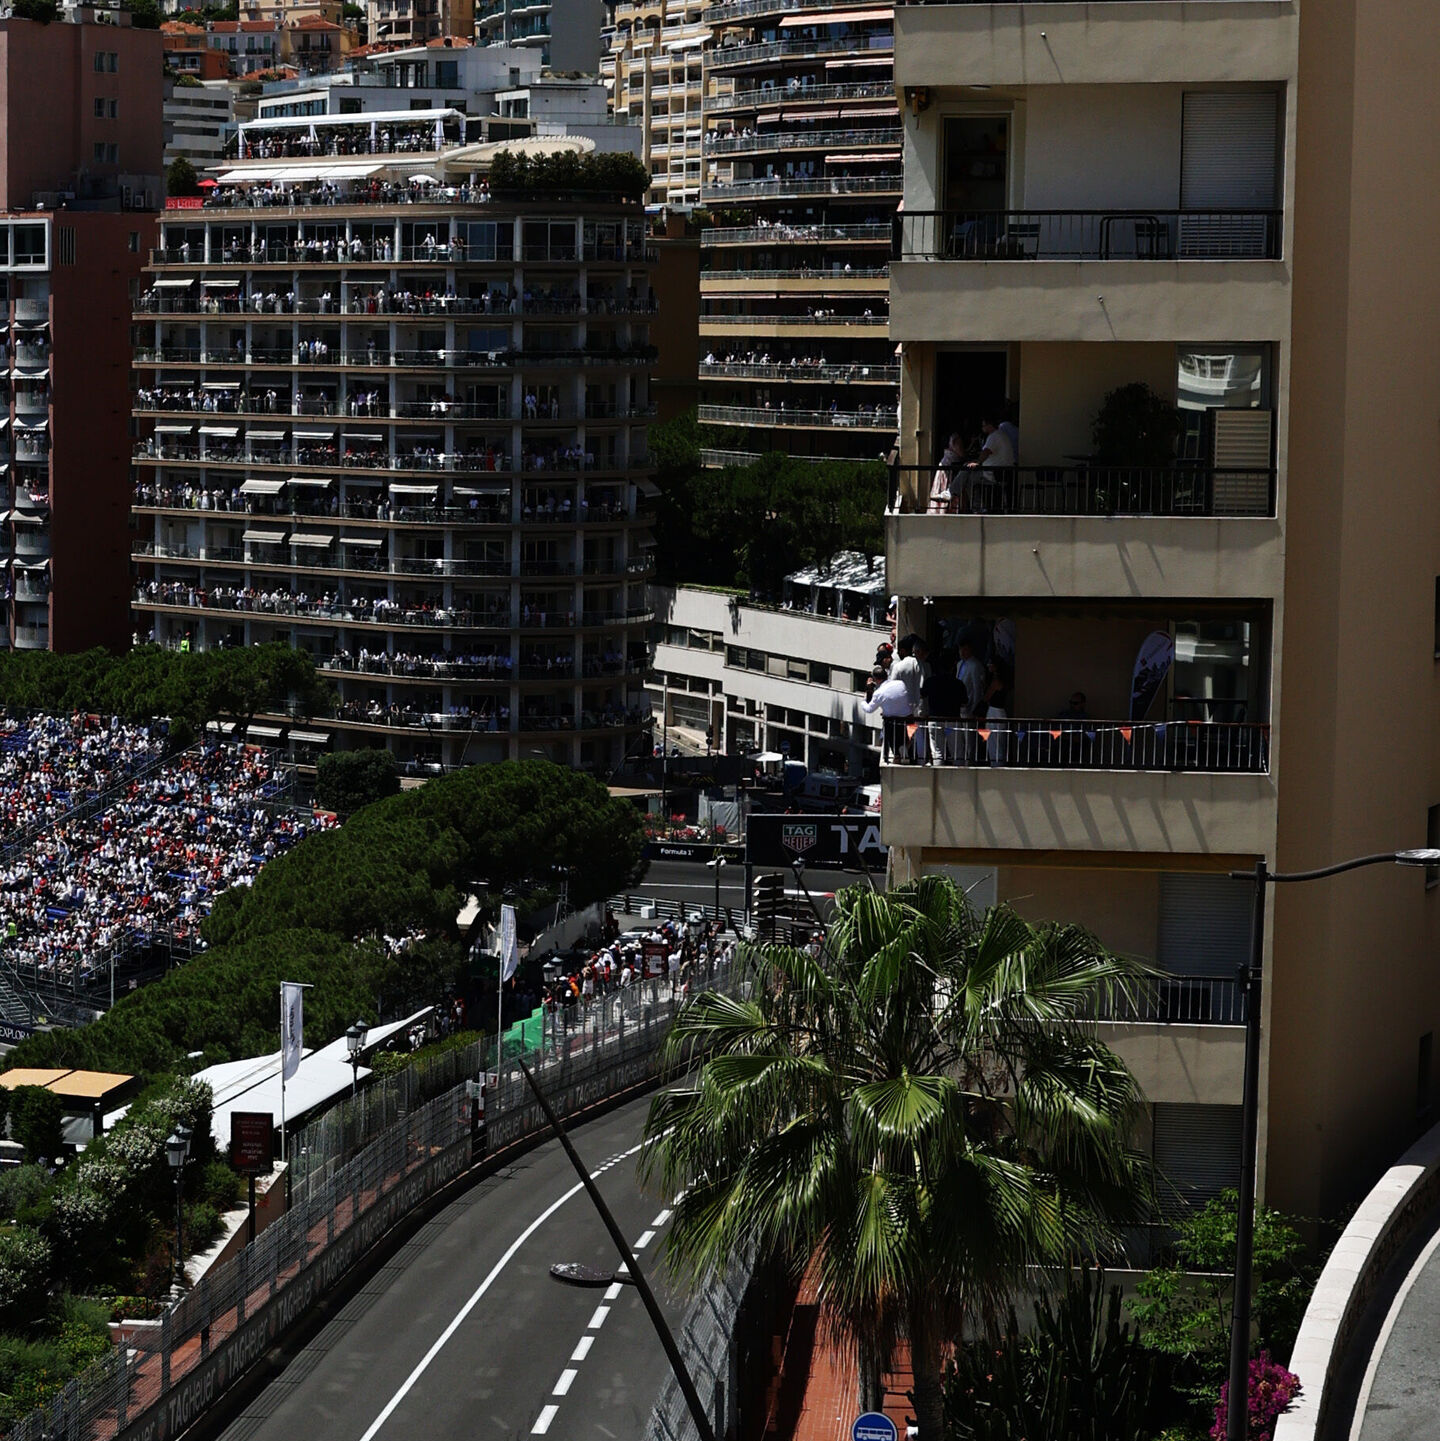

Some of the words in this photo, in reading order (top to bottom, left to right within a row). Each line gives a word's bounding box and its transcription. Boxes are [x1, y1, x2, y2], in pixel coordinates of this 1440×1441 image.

[785, 825, 814, 836] TAG
[783, 837, 816, 851] HEUER
[661, 847, 687, 856] Formula
